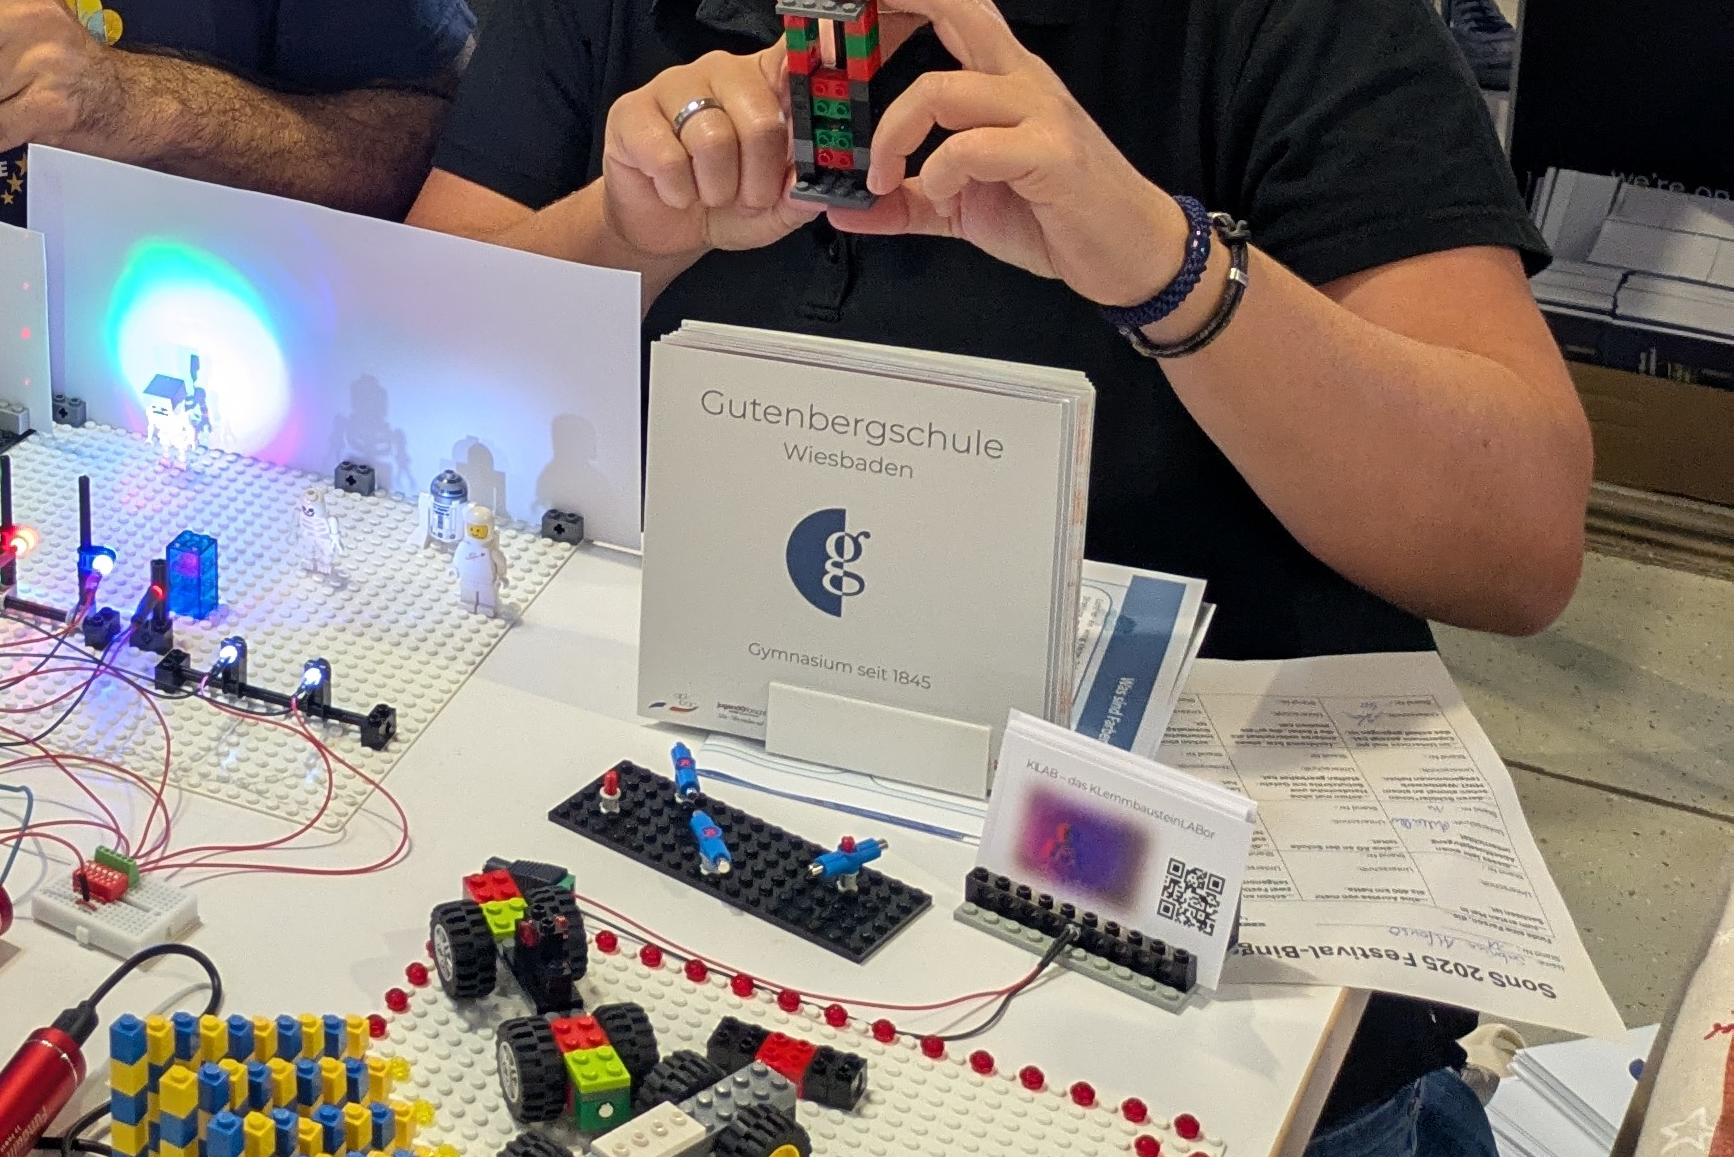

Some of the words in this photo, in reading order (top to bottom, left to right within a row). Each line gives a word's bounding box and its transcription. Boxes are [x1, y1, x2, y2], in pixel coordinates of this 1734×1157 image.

[701, 389, 1004, 459] Gutenbergschule
[783, 442, 914, 479] Wiesbaden
[748, 642, 853, 674] Gymnasium
[857, 664, 888, 682] seit
[893, 669, 932, 690] 1845
[1068, 777, 1088, 792] das
[1090, 785, 1216, 840] KLemmbausteinLABor
[1422, 955, 1483, 981] 2025
[1489, 971, 1557, 999] SonS
